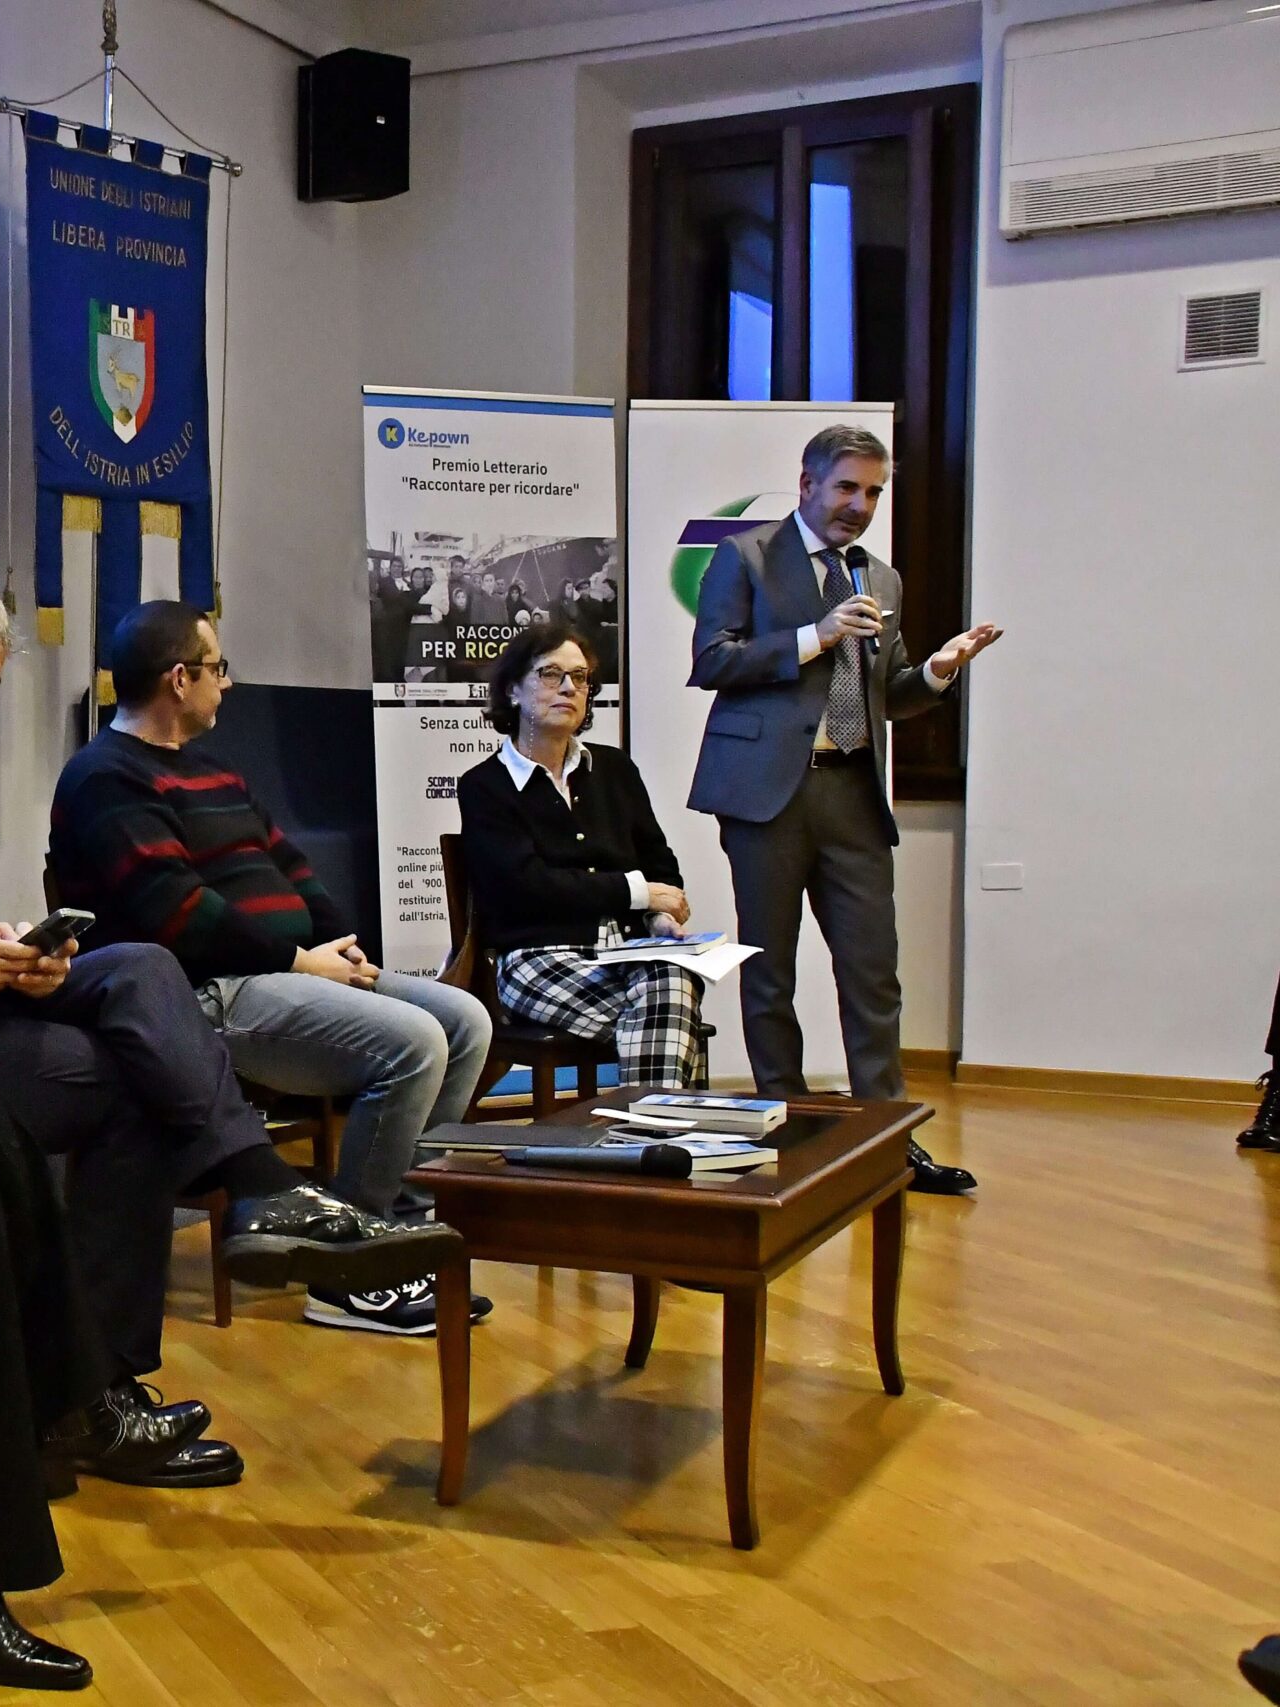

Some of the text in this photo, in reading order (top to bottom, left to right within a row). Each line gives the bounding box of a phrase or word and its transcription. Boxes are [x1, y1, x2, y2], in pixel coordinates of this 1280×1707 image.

[50, 167, 191, 220] UNIONE DEGLI ISTRIANI
[52, 219, 187, 268] LIBERA PROVINCIA
[83, 449, 132, 488] ISTRIA
[136, 461, 150, 486] IN
[152, 421, 194, 479] ESILIO
[432, 457, 548, 476] Premio Letterario
[402, 476, 580, 497] "Raccontare per ricordare"
[422, 640, 457, 659] PER
[420, 716, 460, 730] Senza
[449, 742, 475, 753] non
[478, 738, 494, 753] ha
[427, 776, 455, 788] SCOPRI
[397, 862, 427, 873] online
[398, 878, 413, 889] del
[399, 895, 442, 906] restituire
